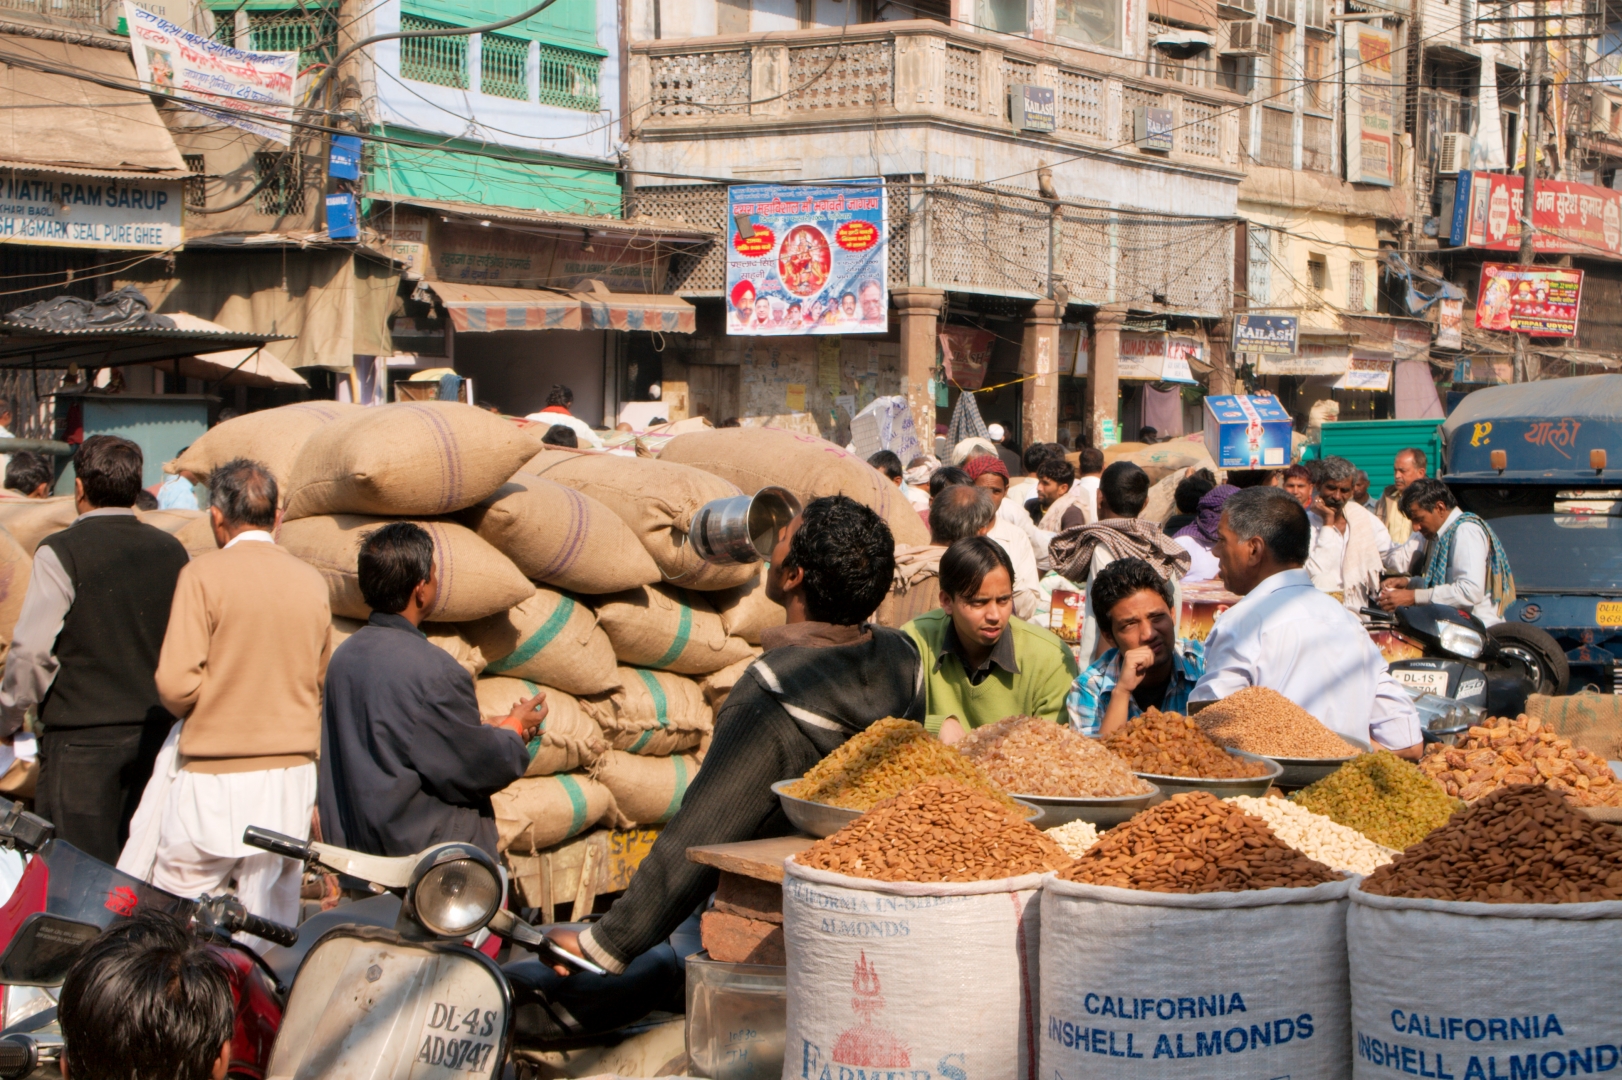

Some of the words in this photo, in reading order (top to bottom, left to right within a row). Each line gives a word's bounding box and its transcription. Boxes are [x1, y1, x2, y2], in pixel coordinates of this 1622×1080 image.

[131, 1, 166, 16] OUCH
[236, 83, 252, 98] 28
[1024, 97, 1054, 116] KAILASH
[1147, 117, 1173, 136] KAILASH
[8, 178, 53, 202] NATH
[61, 183, 102, 207] RAM
[106, 186, 168, 211] SARUP
[28, 206, 55, 217] BAOLI
[1536, 190, 1555, 213] भान
[1557, 184, 1578, 224] सुरेश
[1580, 194, 1603, 226] कुमार
[20, 219, 69, 239] AGMARK
[74, 223, 101, 242] SEAL
[104, 225, 132, 243] PURE
[134, 226, 162, 245] GHEE
[1236, 324, 1296, 341] KAILASH
[1546, 321, 1574, 331] UDYOG
[1120, 339, 1146, 356] KUMAR
[1147, 340, 1165, 357] SONS
[1599, 614, 1622, 624] 968
[1403, 673, 1435, 683] DL-1S
[820, 917, 911, 938] ALMONDS
[1083, 992, 1248, 1021] CALIFORNIA
[1390, 1009, 1565, 1042] CALIFORNIA
[1048, 1014, 1145, 1059] INSHELL
[1152, 1012, 1315, 1059] ALMONDS
[415, 1034, 495, 1074] AD9747
[1357, 1031, 1458, 1077] INSHELL
[1465, 1044, 1622, 1080] ALMOND
